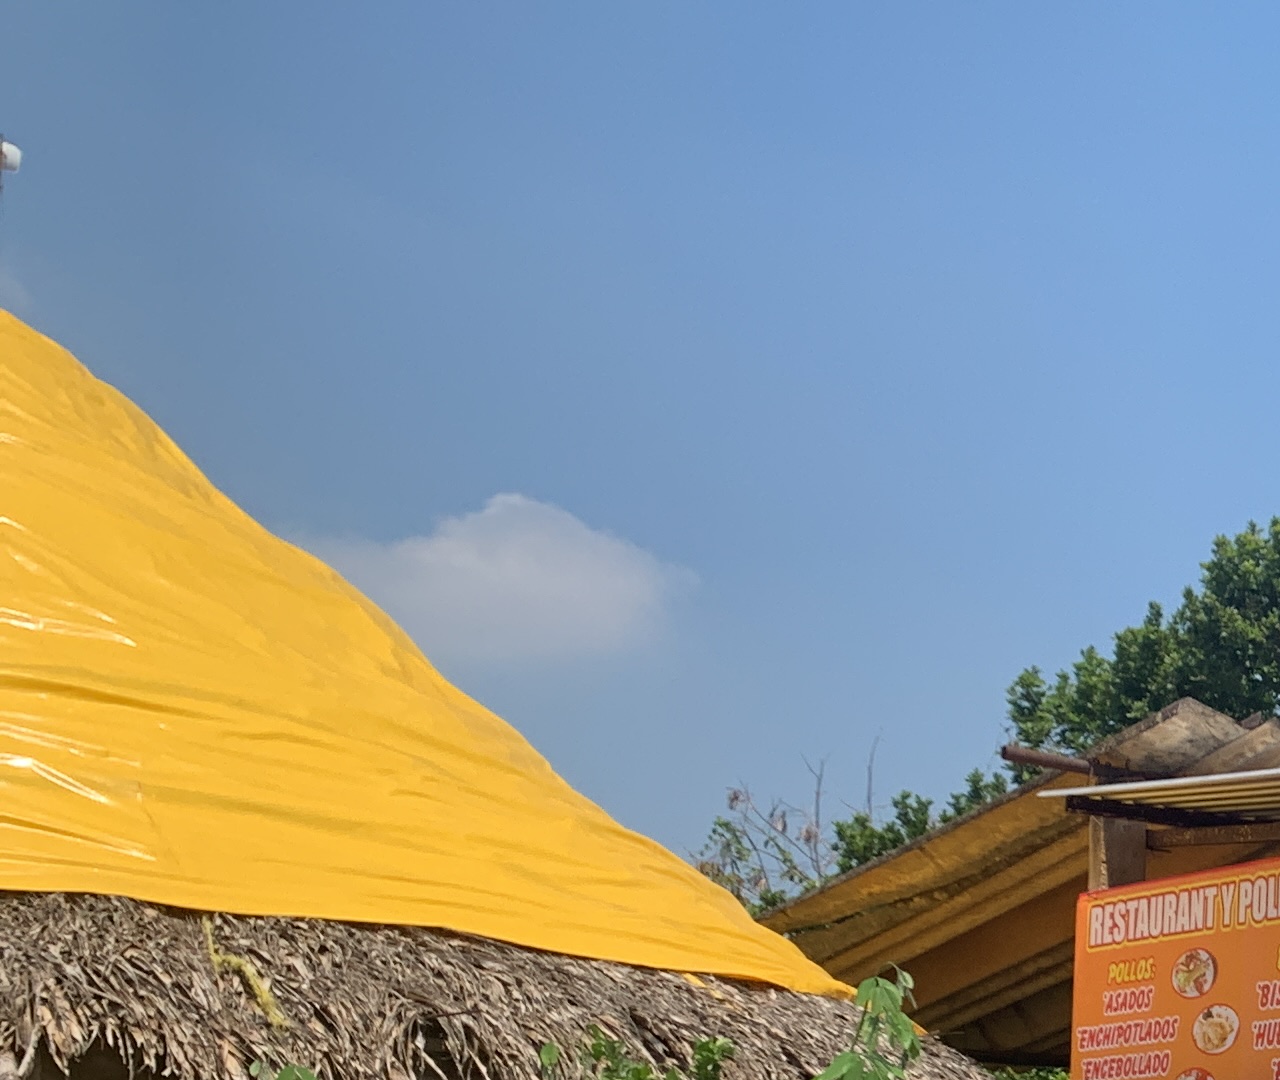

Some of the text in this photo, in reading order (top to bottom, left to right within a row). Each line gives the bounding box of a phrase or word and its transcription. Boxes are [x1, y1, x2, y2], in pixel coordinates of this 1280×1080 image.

[1090, 885, 1218, 947] RESTAURANT
[1219, 883, 1235, 925] Y
[1108, 958, 1155, 982] POLLOS:
[1106, 989, 1152, 1013] ASADOS
[1080, 1019, 1177, 1049] ENCHIPOTLADOS
[1083, 1053, 1169, 1080] ENCEBOLLADO
